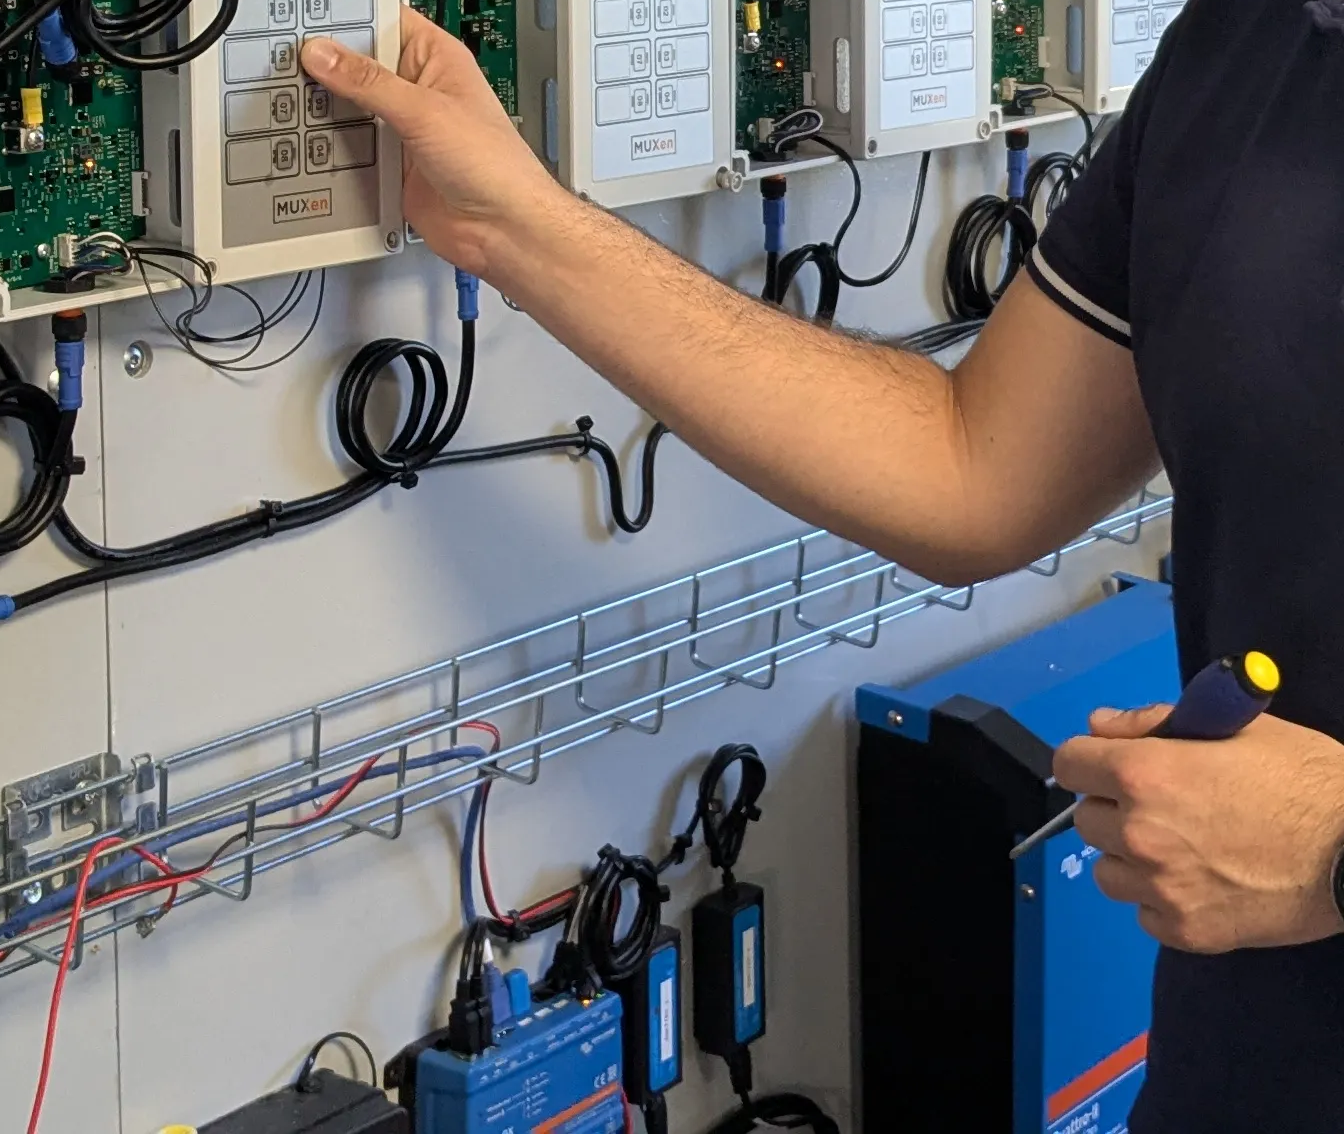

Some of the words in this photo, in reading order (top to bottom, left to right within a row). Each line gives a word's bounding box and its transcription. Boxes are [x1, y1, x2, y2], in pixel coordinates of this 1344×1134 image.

[278, 2, 286, 15] 05
[313, 0, 321, 11] 01
[279, 50, 287, 63] 06
[280, 102, 287, 115] 07
[316, 144, 324, 158] 04
[634, 139, 674, 154] MUXen
[281, 149, 288, 163] 08
[277, 198, 328, 216] MUXen
